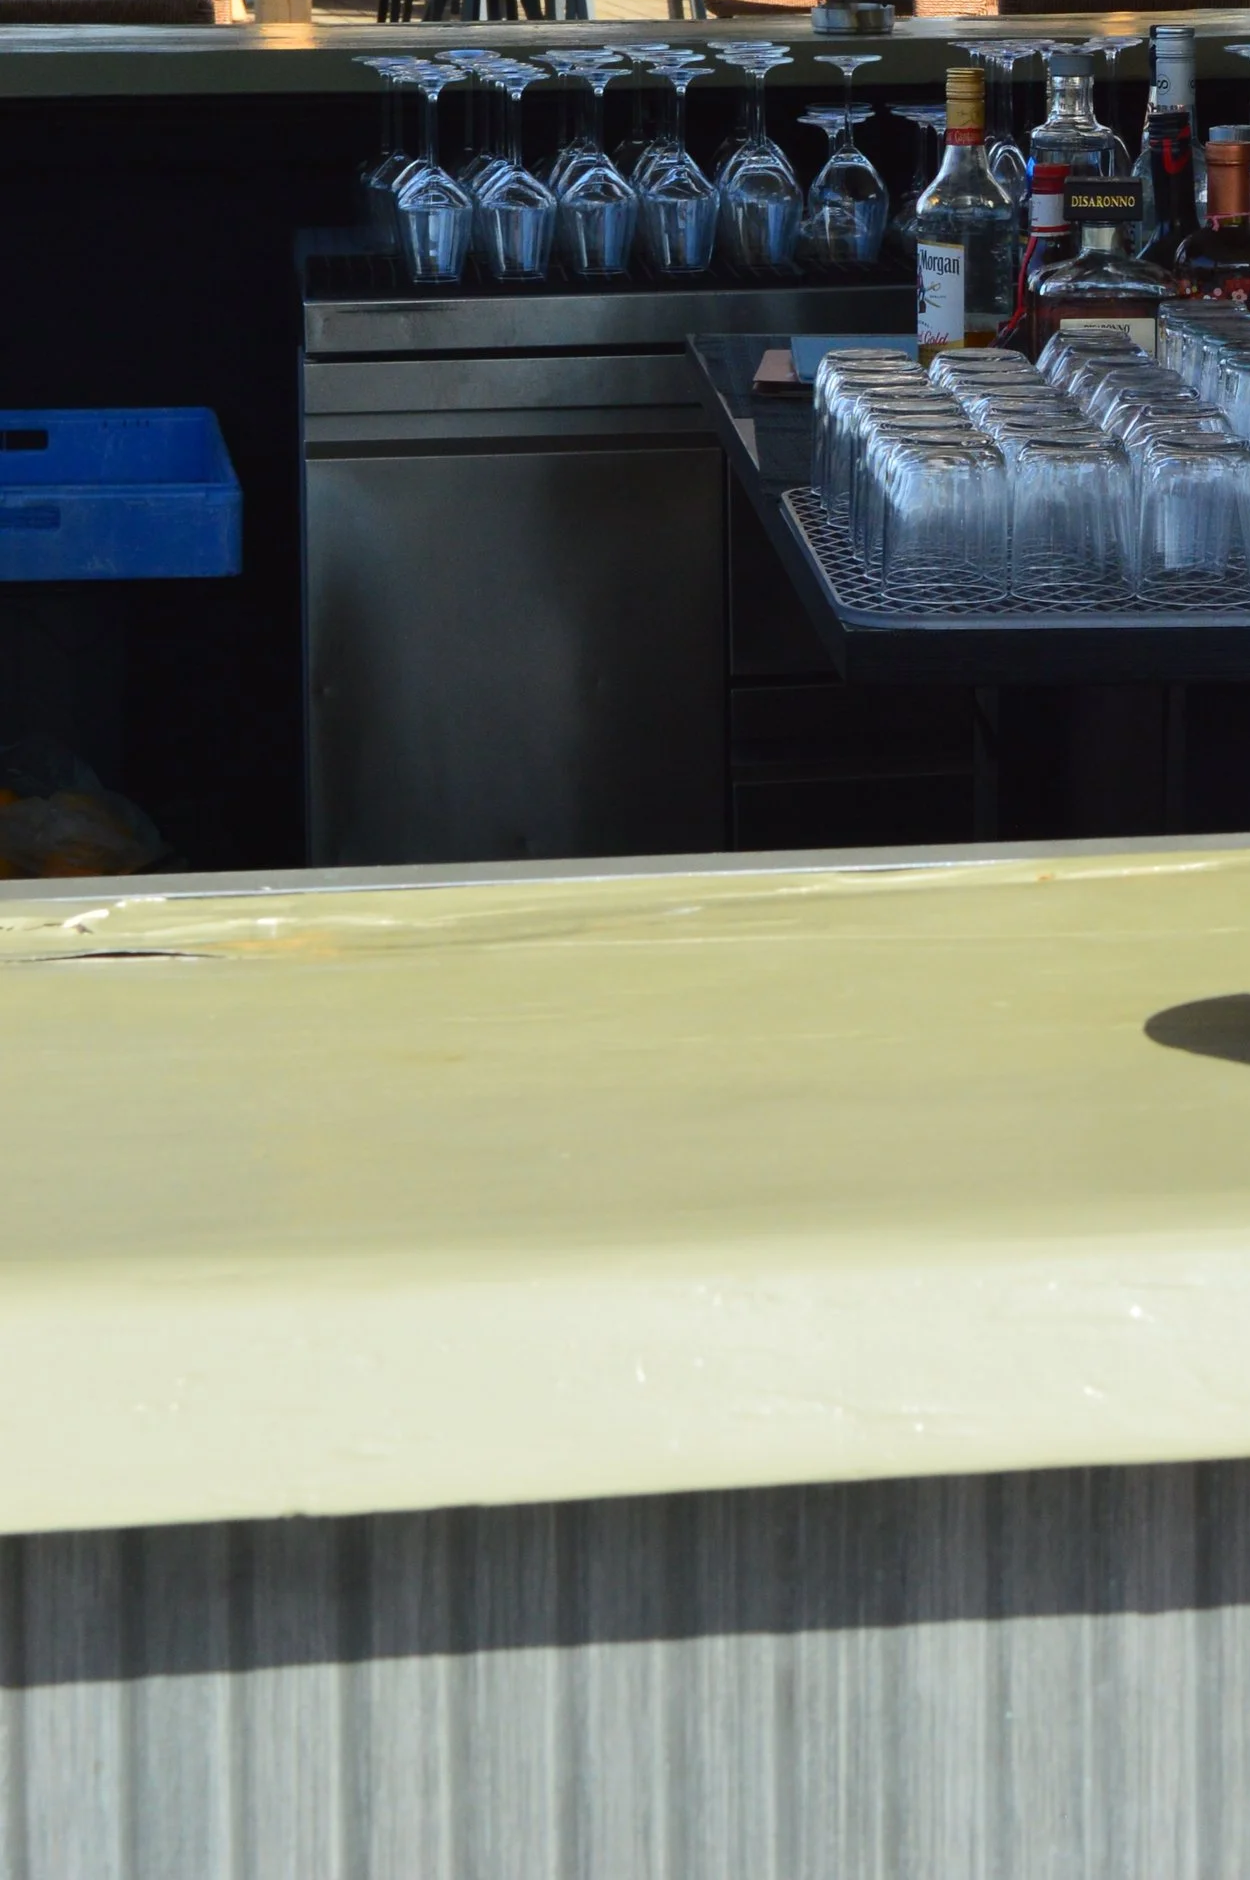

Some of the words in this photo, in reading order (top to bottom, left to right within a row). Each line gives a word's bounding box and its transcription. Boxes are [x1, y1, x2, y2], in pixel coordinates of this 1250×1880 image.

[1071, 195, 1137, 208] DISARONNO
[919, 249, 960, 276] Morgan
[923, 330, 949, 345] Gold
